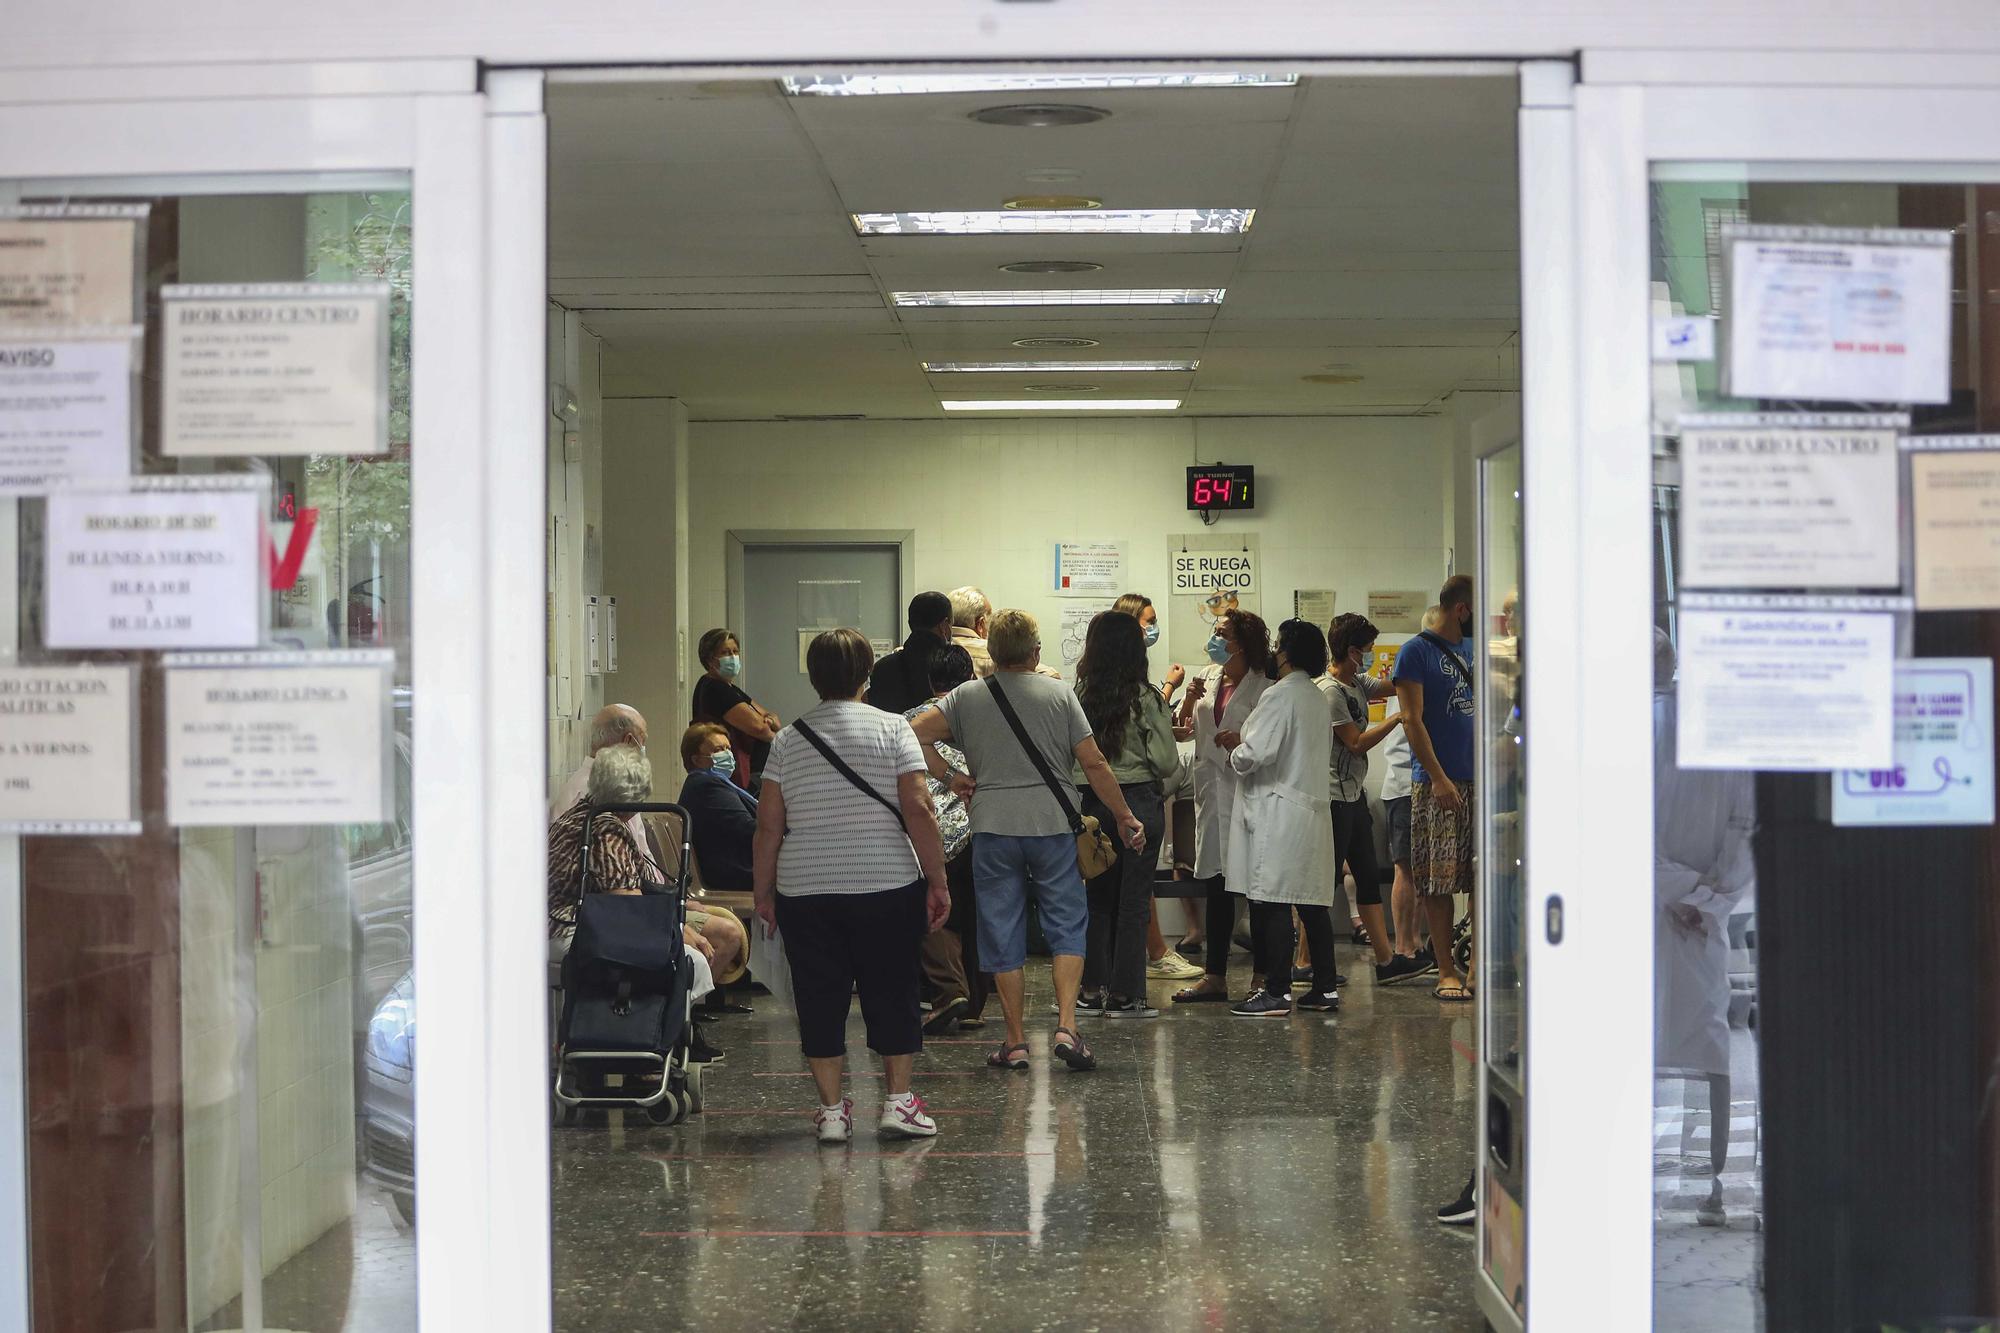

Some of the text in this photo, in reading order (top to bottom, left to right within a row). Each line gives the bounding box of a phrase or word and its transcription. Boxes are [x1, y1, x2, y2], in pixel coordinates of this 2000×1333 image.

[1194, 479, 1248, 504] 64 1
[87, 515, 160, 530] HORARIO
[1176, 557, 1251, 571] SE RUEGA
[1176, 573, 1251, 588] SILENCIO
